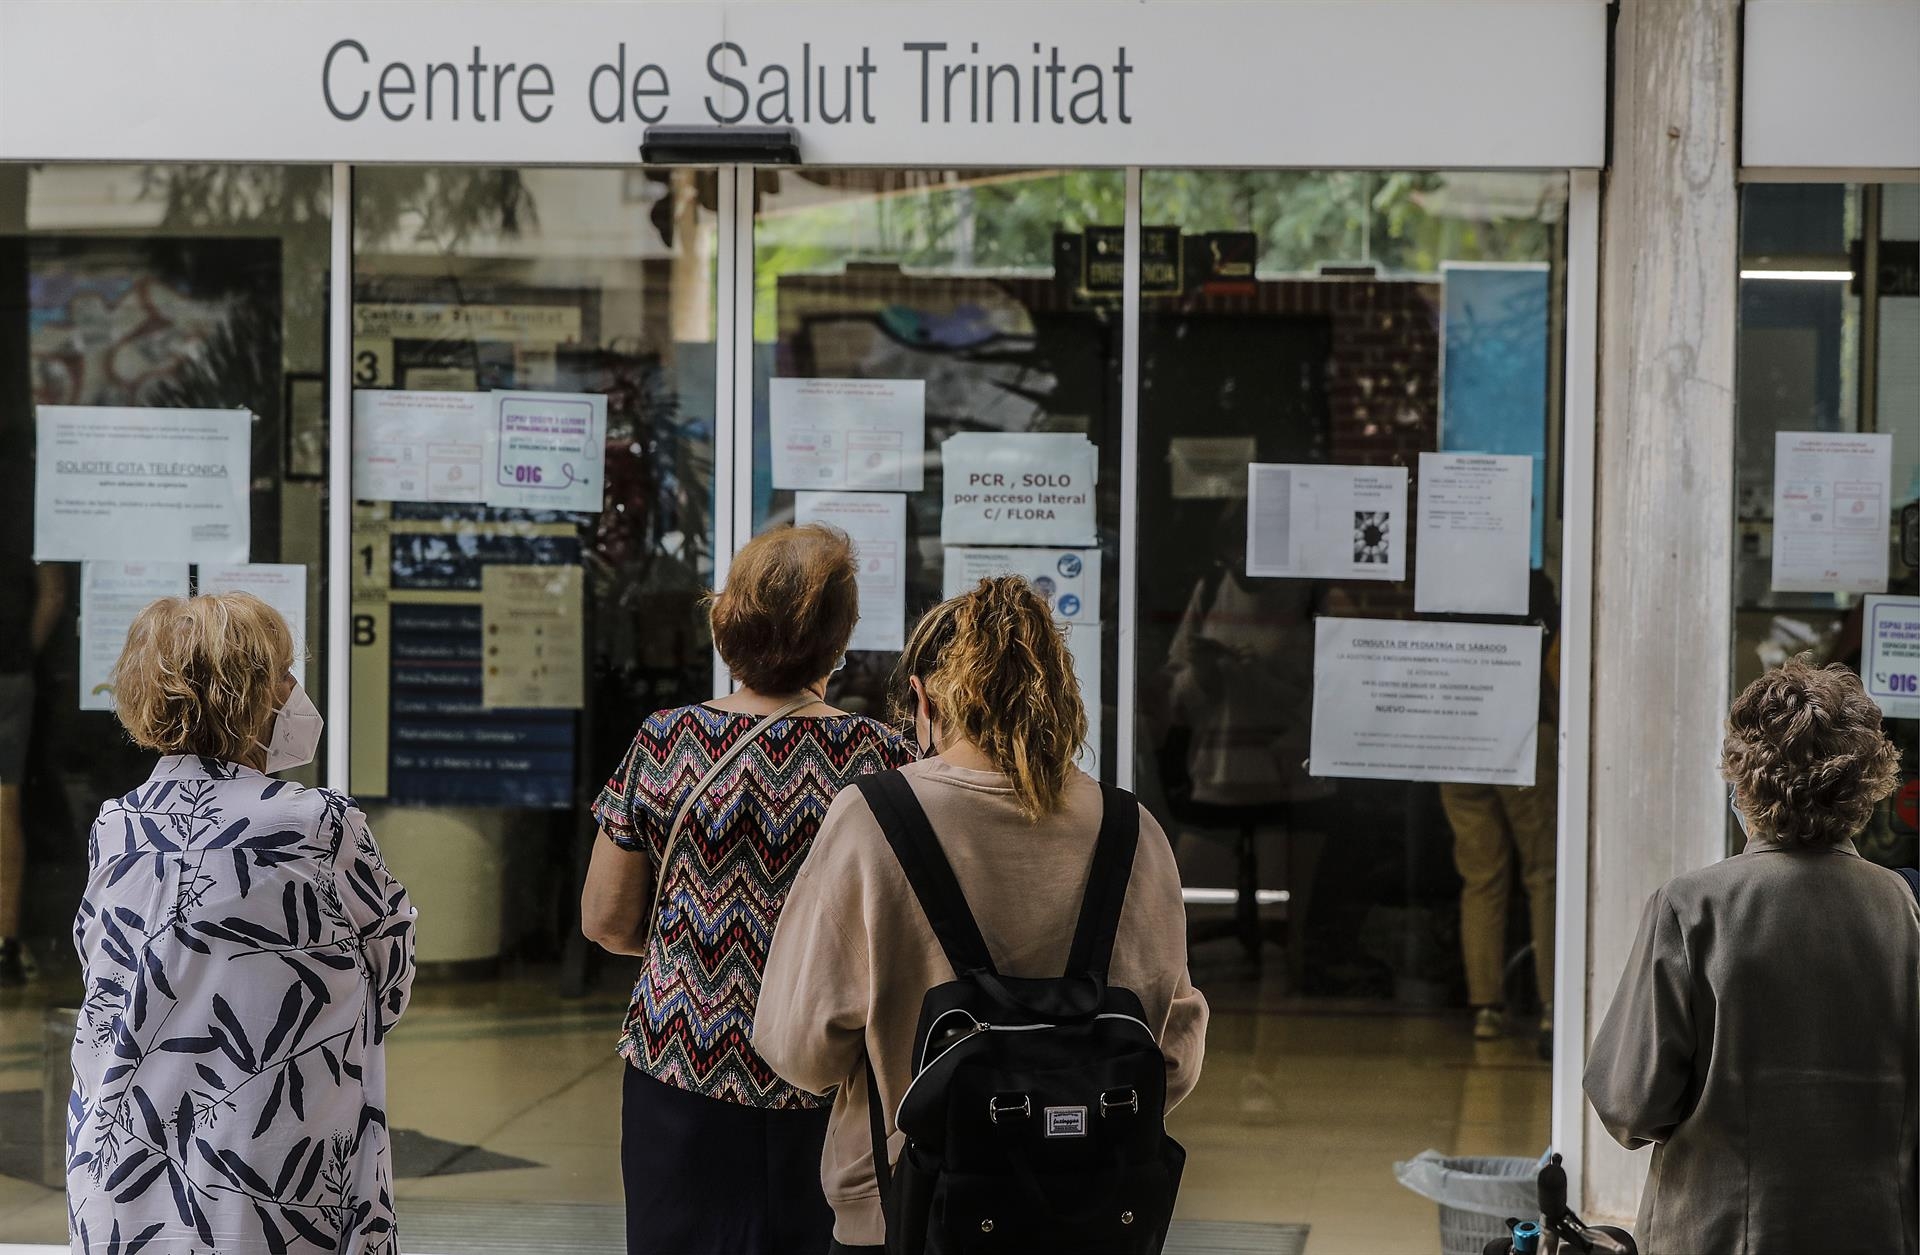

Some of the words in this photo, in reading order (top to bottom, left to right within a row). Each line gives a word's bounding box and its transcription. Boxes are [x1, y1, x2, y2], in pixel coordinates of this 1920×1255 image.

[322, 38, 555, 123] Centre
[588, 42, 671, 124] de
[704, 41, 878, 125] Salut
[902, 42, 1134, 125] Trinitat
[356, 351, 378, 384] 3
[56, 460, 113, 474] SOLICITE
[117, 461, 145, 475] CITA
[515, 465, 542, 483] 016
[969, 473, 1005, 487] PCR
[1021, 473, 1072, 488] SOLO
[954, 494, 979, 505] por
[983, 494, 1034, 504] acceso
[1037, 492, 1087, 505] lateral
[983, 508, 1001, 522] C/
[1007, 508, 1056, 521] FLORA
[359, 545, 373, 576] 1
[353, 615, 376, 647] B
[1352, 638, 1395, 649] CONSULTA
[1398, 640, 1408, 649] DE
[1455, 643, 1466, 652] DE
[1889, 673, 1917, 692] 016
[1375, 704, 1405, 713] NUEVO
